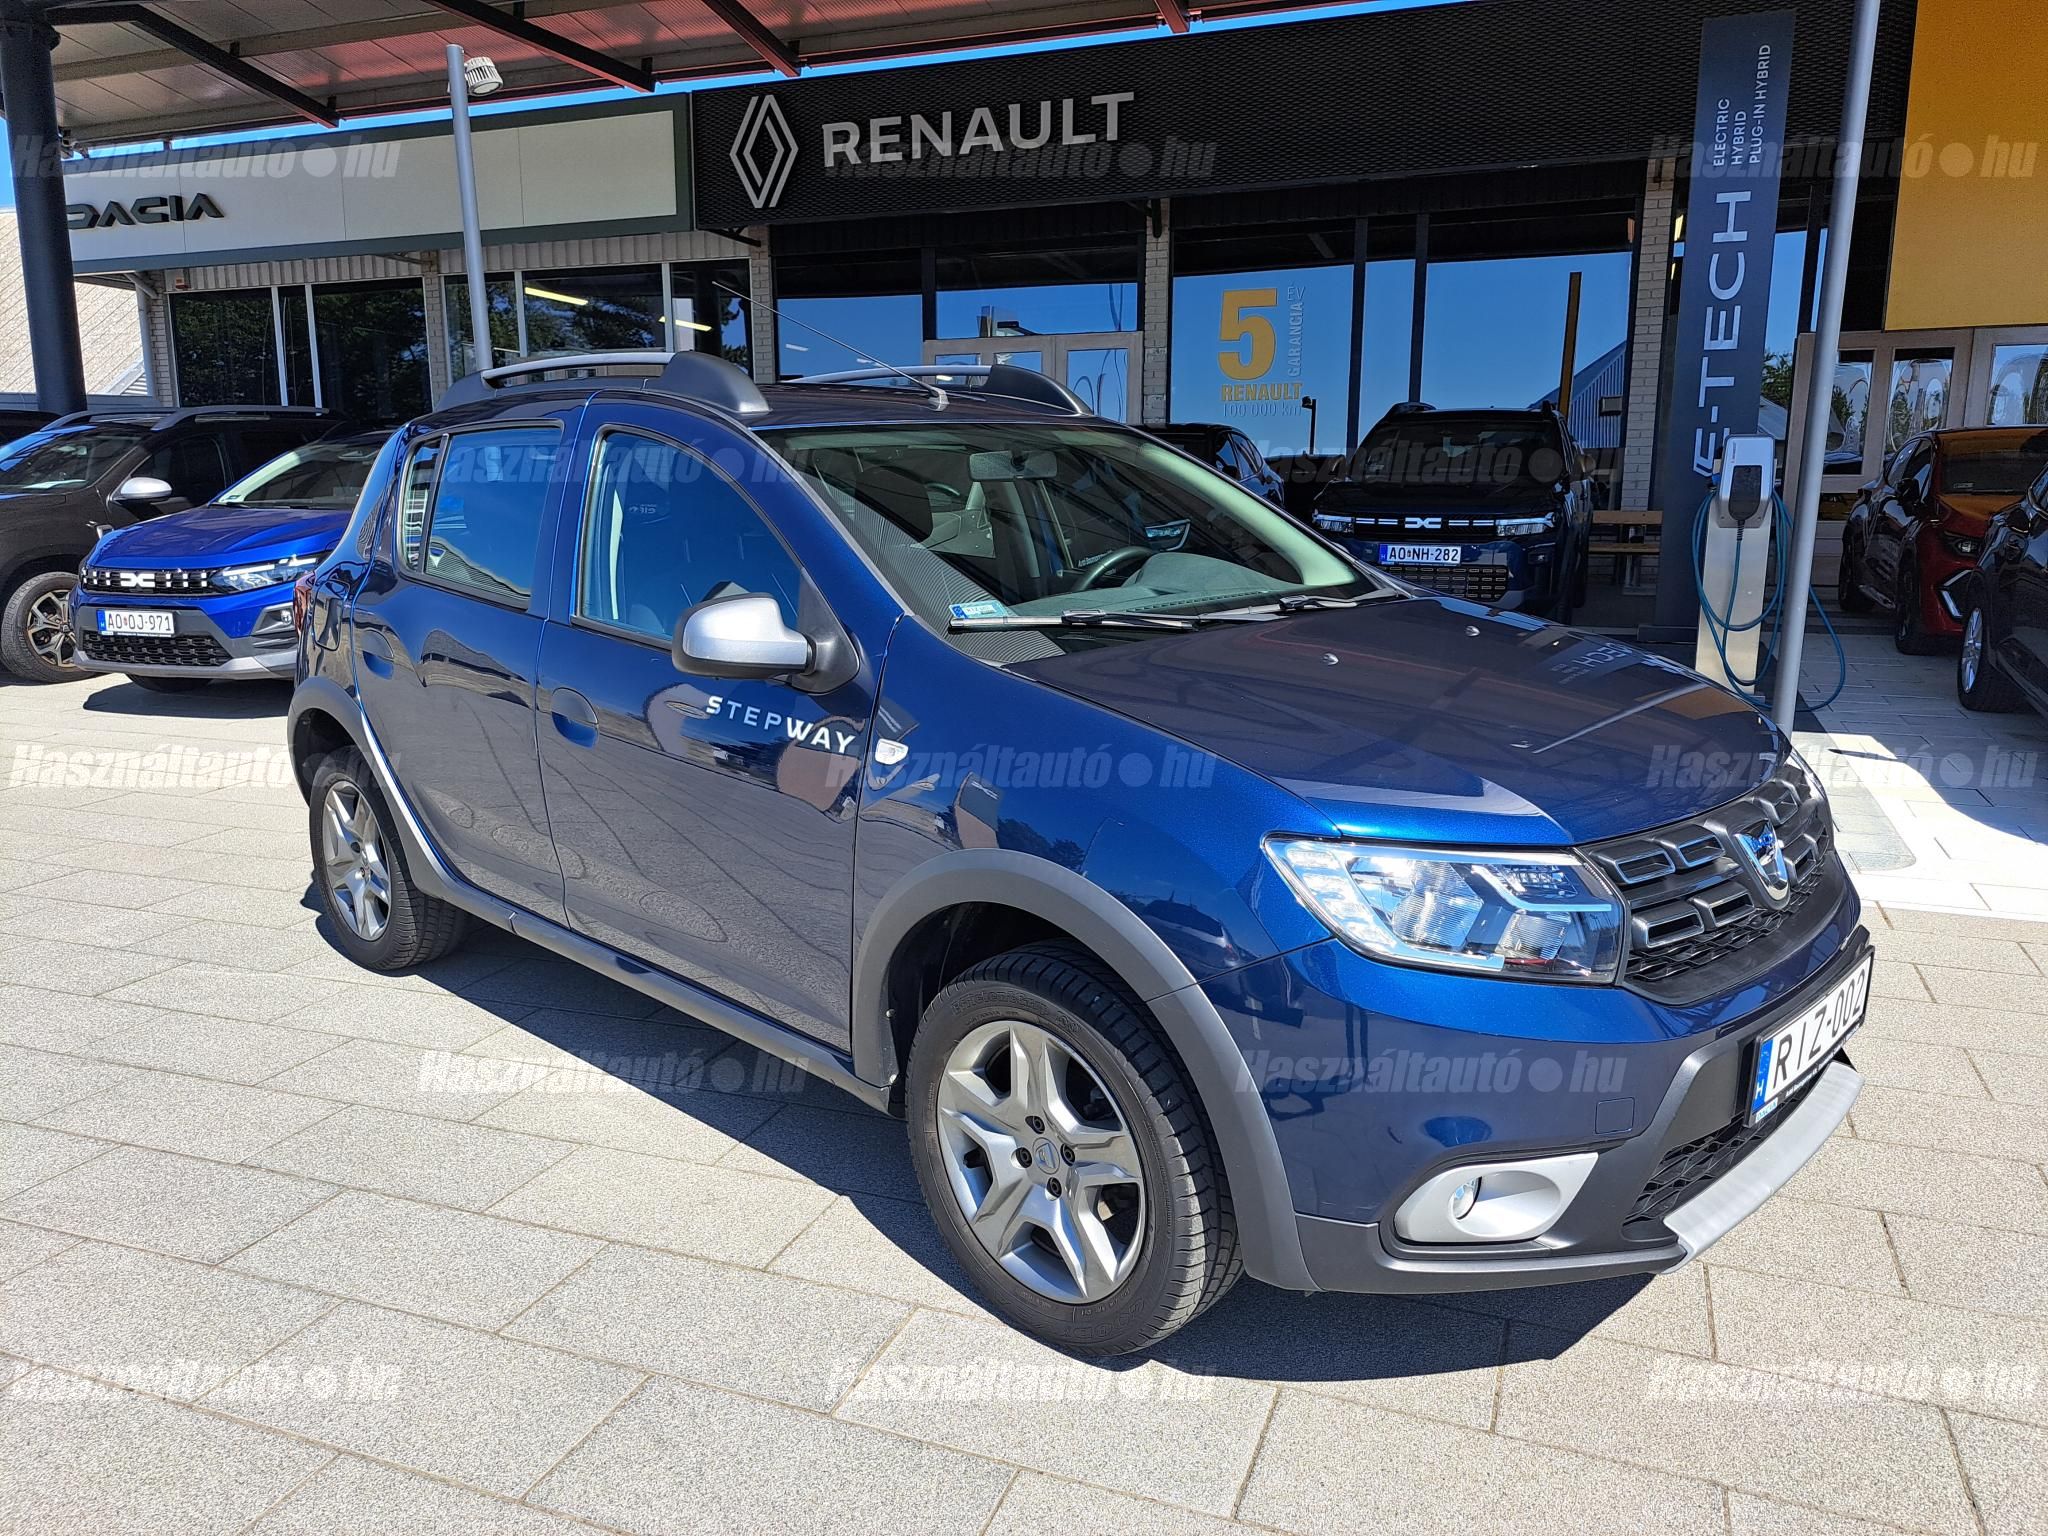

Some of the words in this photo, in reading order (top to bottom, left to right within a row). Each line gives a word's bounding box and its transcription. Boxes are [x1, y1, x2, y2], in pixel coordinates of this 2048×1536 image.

[1755, 44, 1771, 100] HYBRID
[822, 92, 1134, 167] RENAULT
[1713, 98, 1730, 167] ELECTRIC
[1731, 111, 1747, 165] HYBRID
[1749, 103, 1766, 164] PLUG-IN
[67, 193, 224, 230] DACIA
[1218, 287, 1278, 381] 5
[1288, 300, 1304, 377] GARANCIA
[1693, 191, 1752, 478] E-TECH
[1221, 383, 1303, 402] RENAULT
[1222, 402, 1247, 418] 100
[1250, 402, 1277, 417] 000
[706, 695, 855, 755] STEPWAY
[1773, 968, 1866, 1089] RIZ-002
